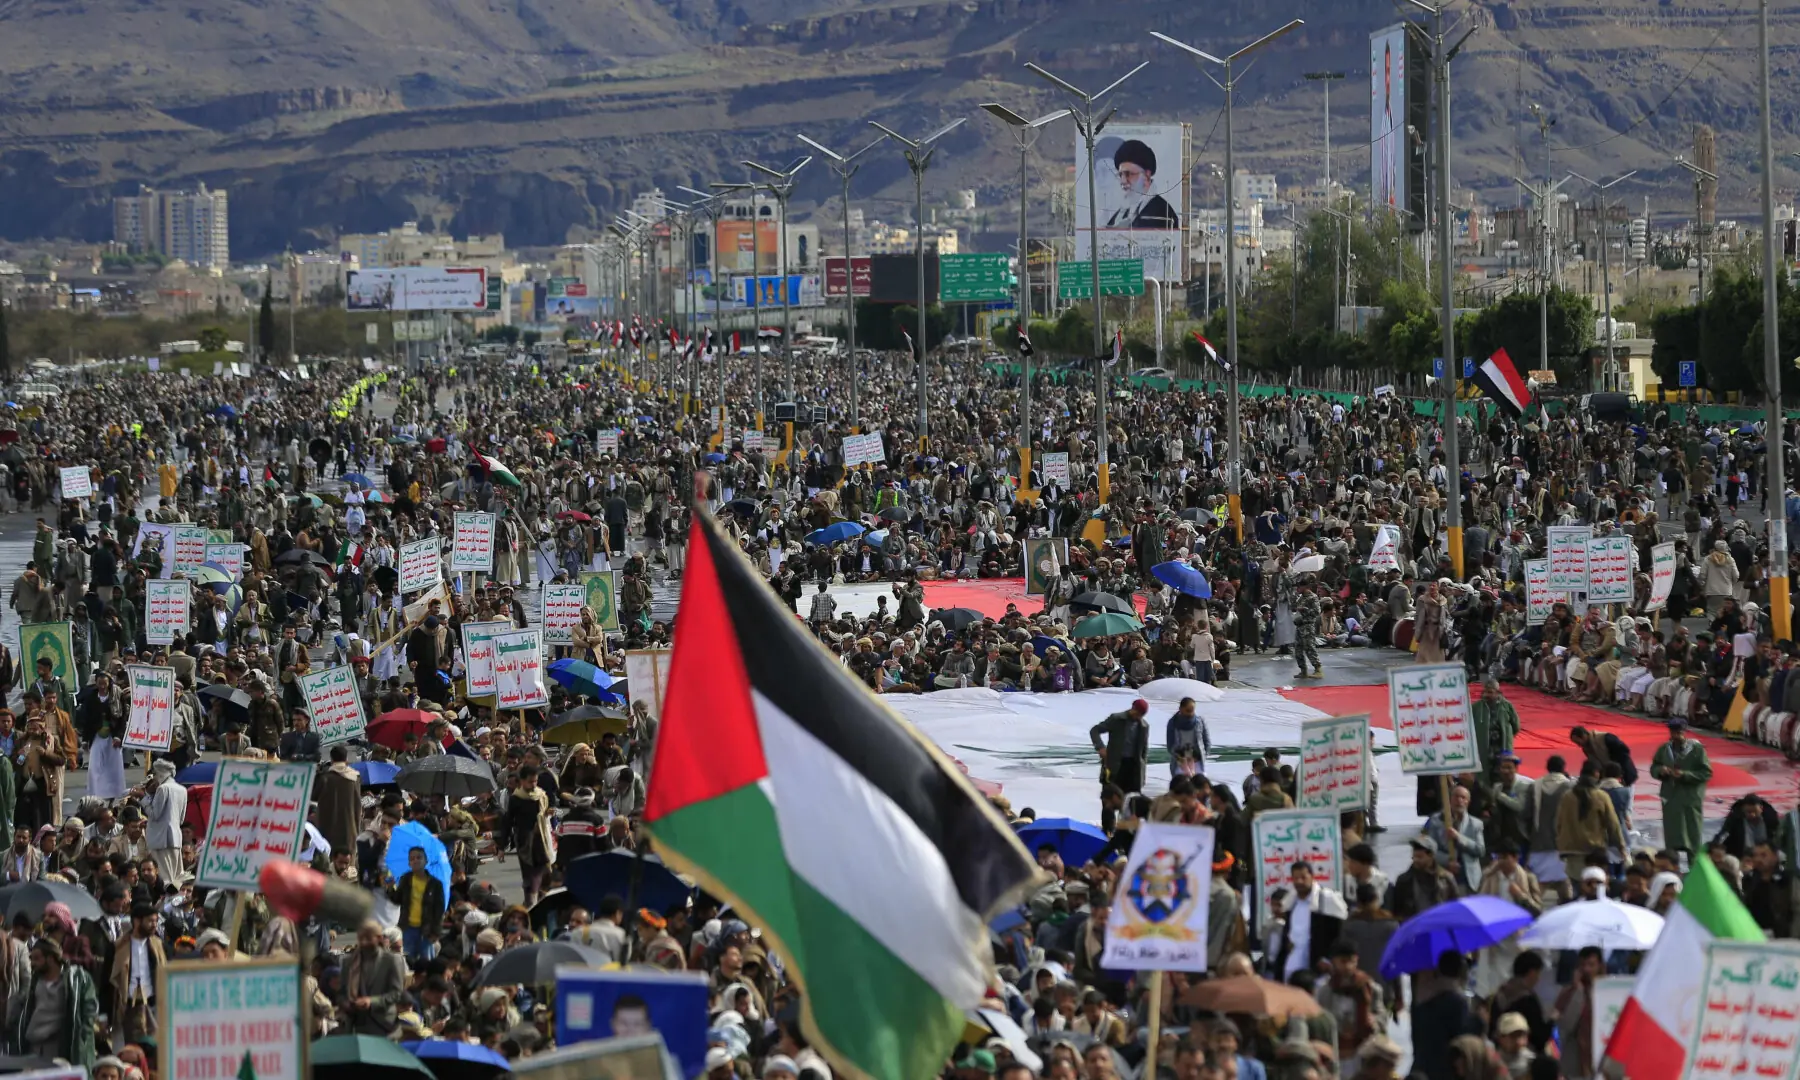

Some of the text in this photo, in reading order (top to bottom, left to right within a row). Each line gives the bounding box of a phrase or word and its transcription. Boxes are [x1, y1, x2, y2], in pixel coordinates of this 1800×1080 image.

[1683, 364, 1690, 373] P
[274, 768, 306, 789] الله
[175, 979, 206, 1011] ALLAH
[210, 978, 219, 1009] IS
[221, 976, 241, 1010] THE
[176, 1020, 292, 1048] DEATH TO AMERICA
[176, 1056, 216, 1078] DEATH
[221, 1055, 237, 1078] TO
